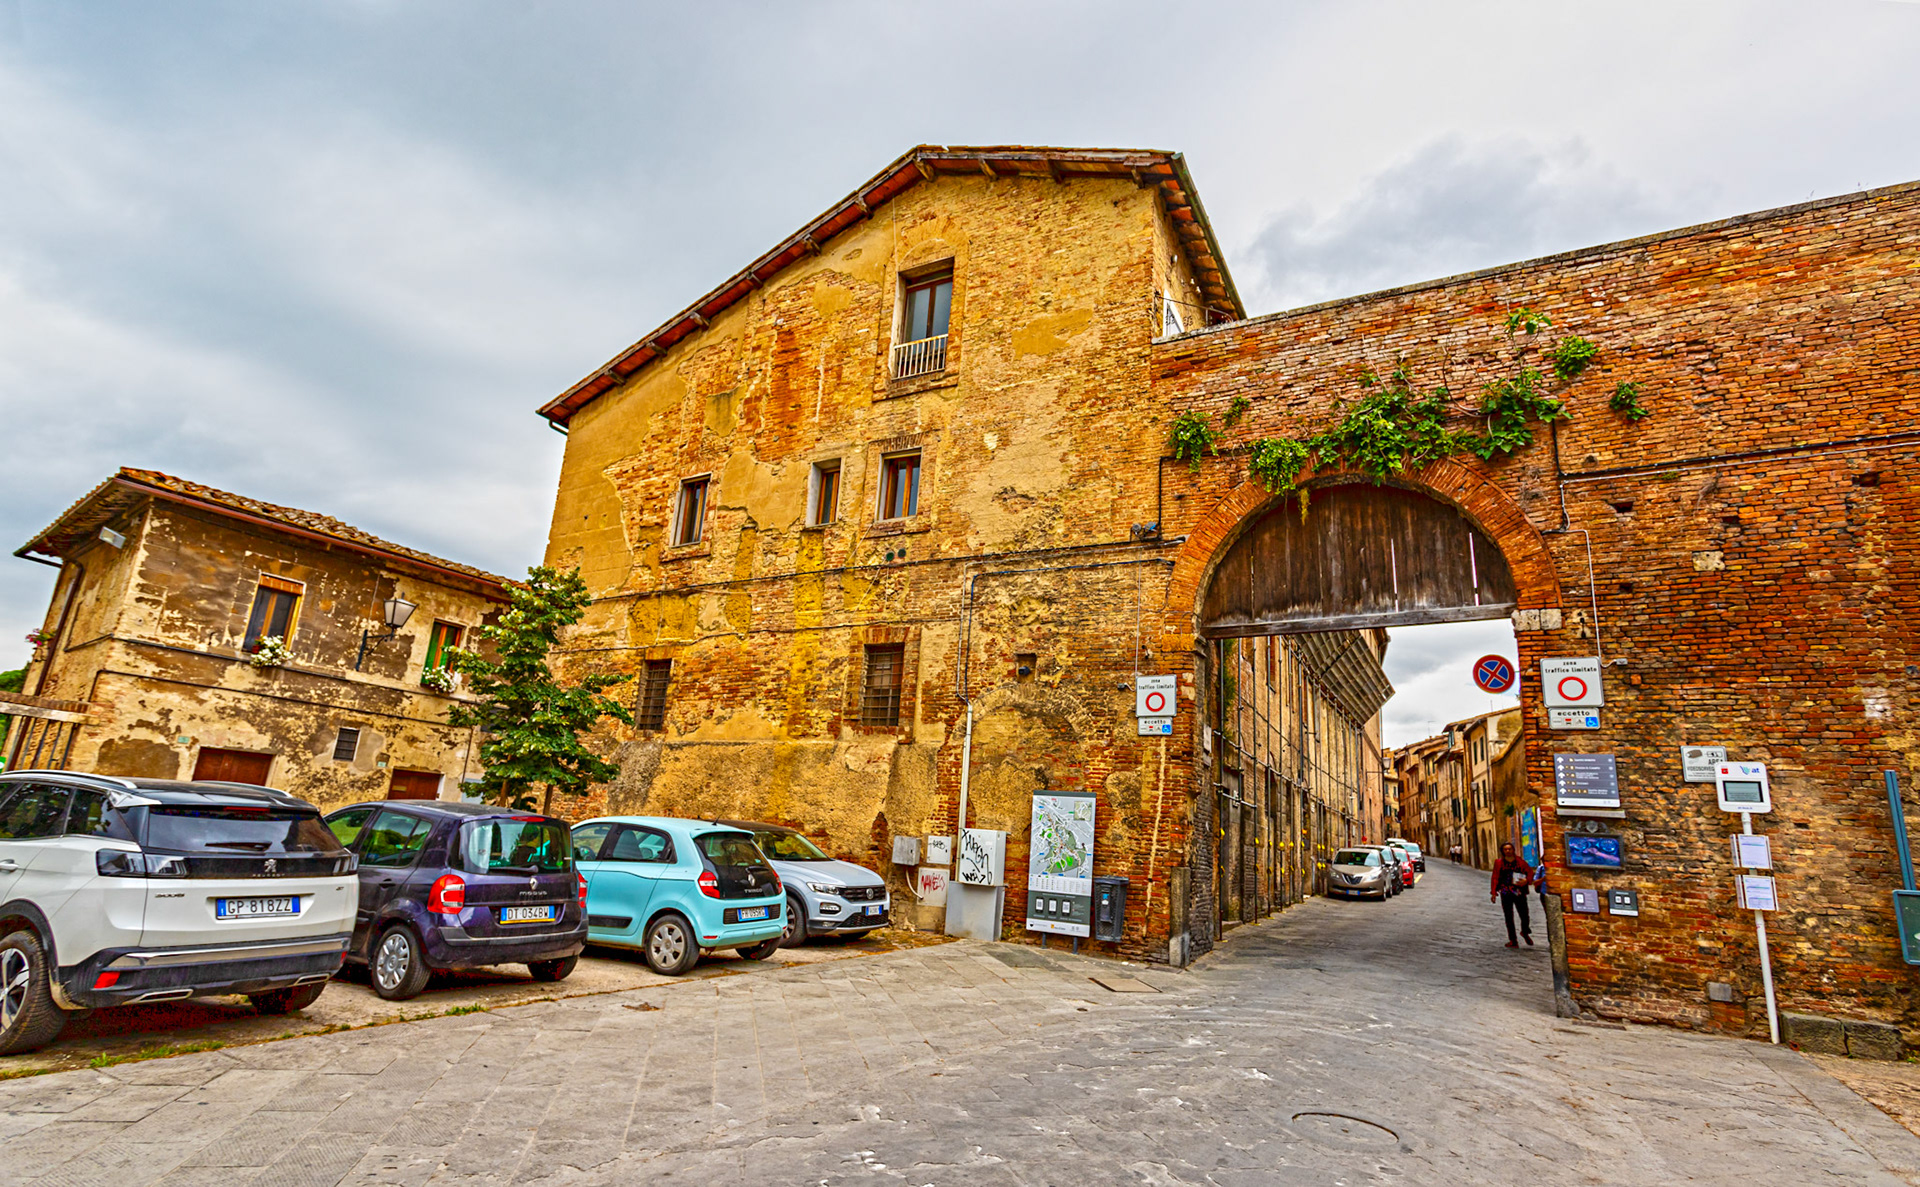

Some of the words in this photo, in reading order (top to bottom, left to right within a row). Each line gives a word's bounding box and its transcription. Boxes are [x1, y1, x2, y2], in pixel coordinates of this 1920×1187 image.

[228, 900, 244, 914] GP
[250, 898, 292, 912] 818ZZ
[508, 908, 518, 920] DT
